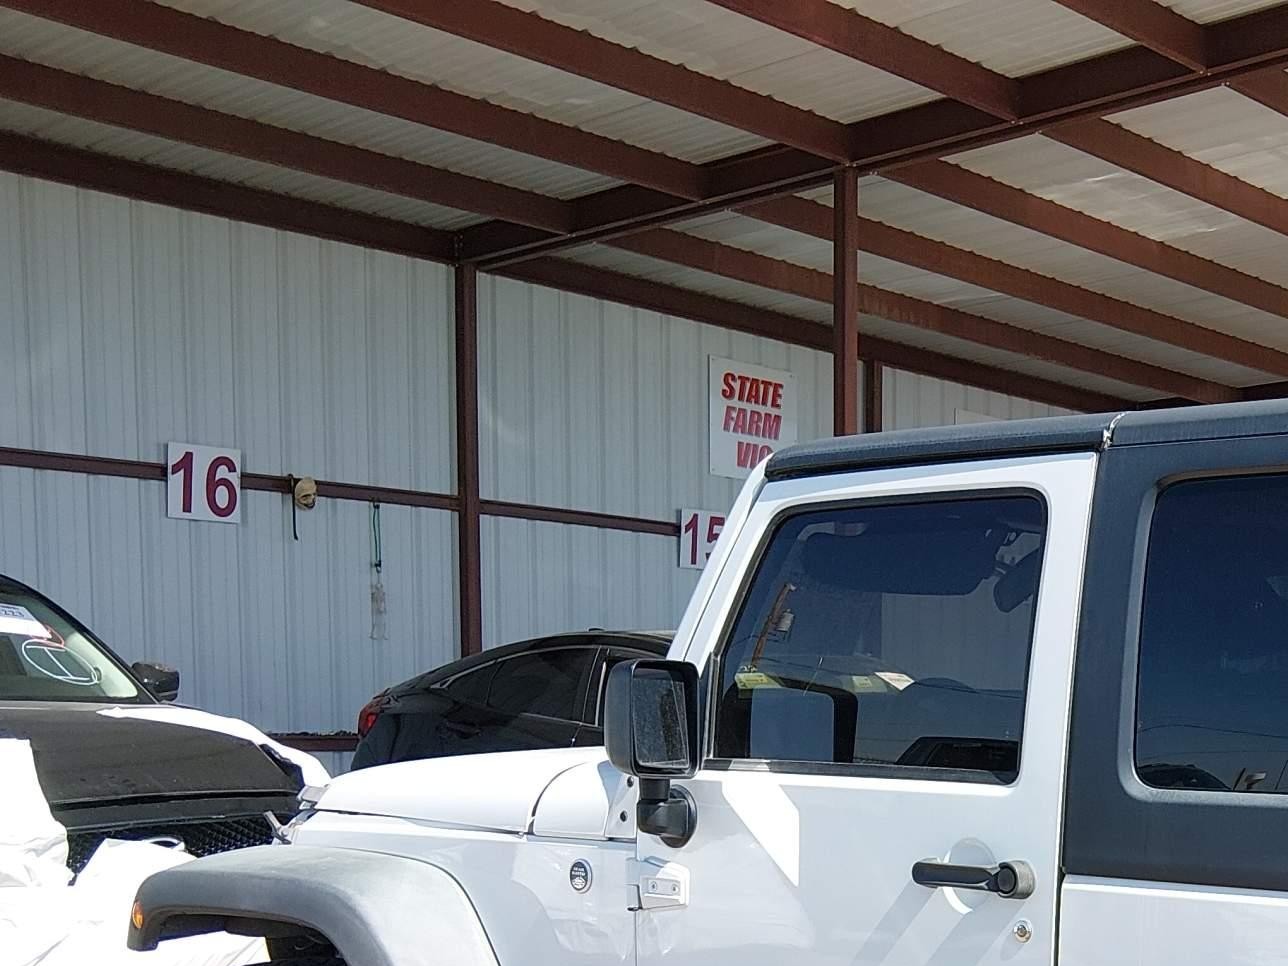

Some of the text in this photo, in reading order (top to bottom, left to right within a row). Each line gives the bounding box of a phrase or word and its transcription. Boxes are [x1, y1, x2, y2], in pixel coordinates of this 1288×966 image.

[721, 372, 784, 410] STATE
[722, 405, 783, 441] FARM
[171, 451, 238, 517] 16
